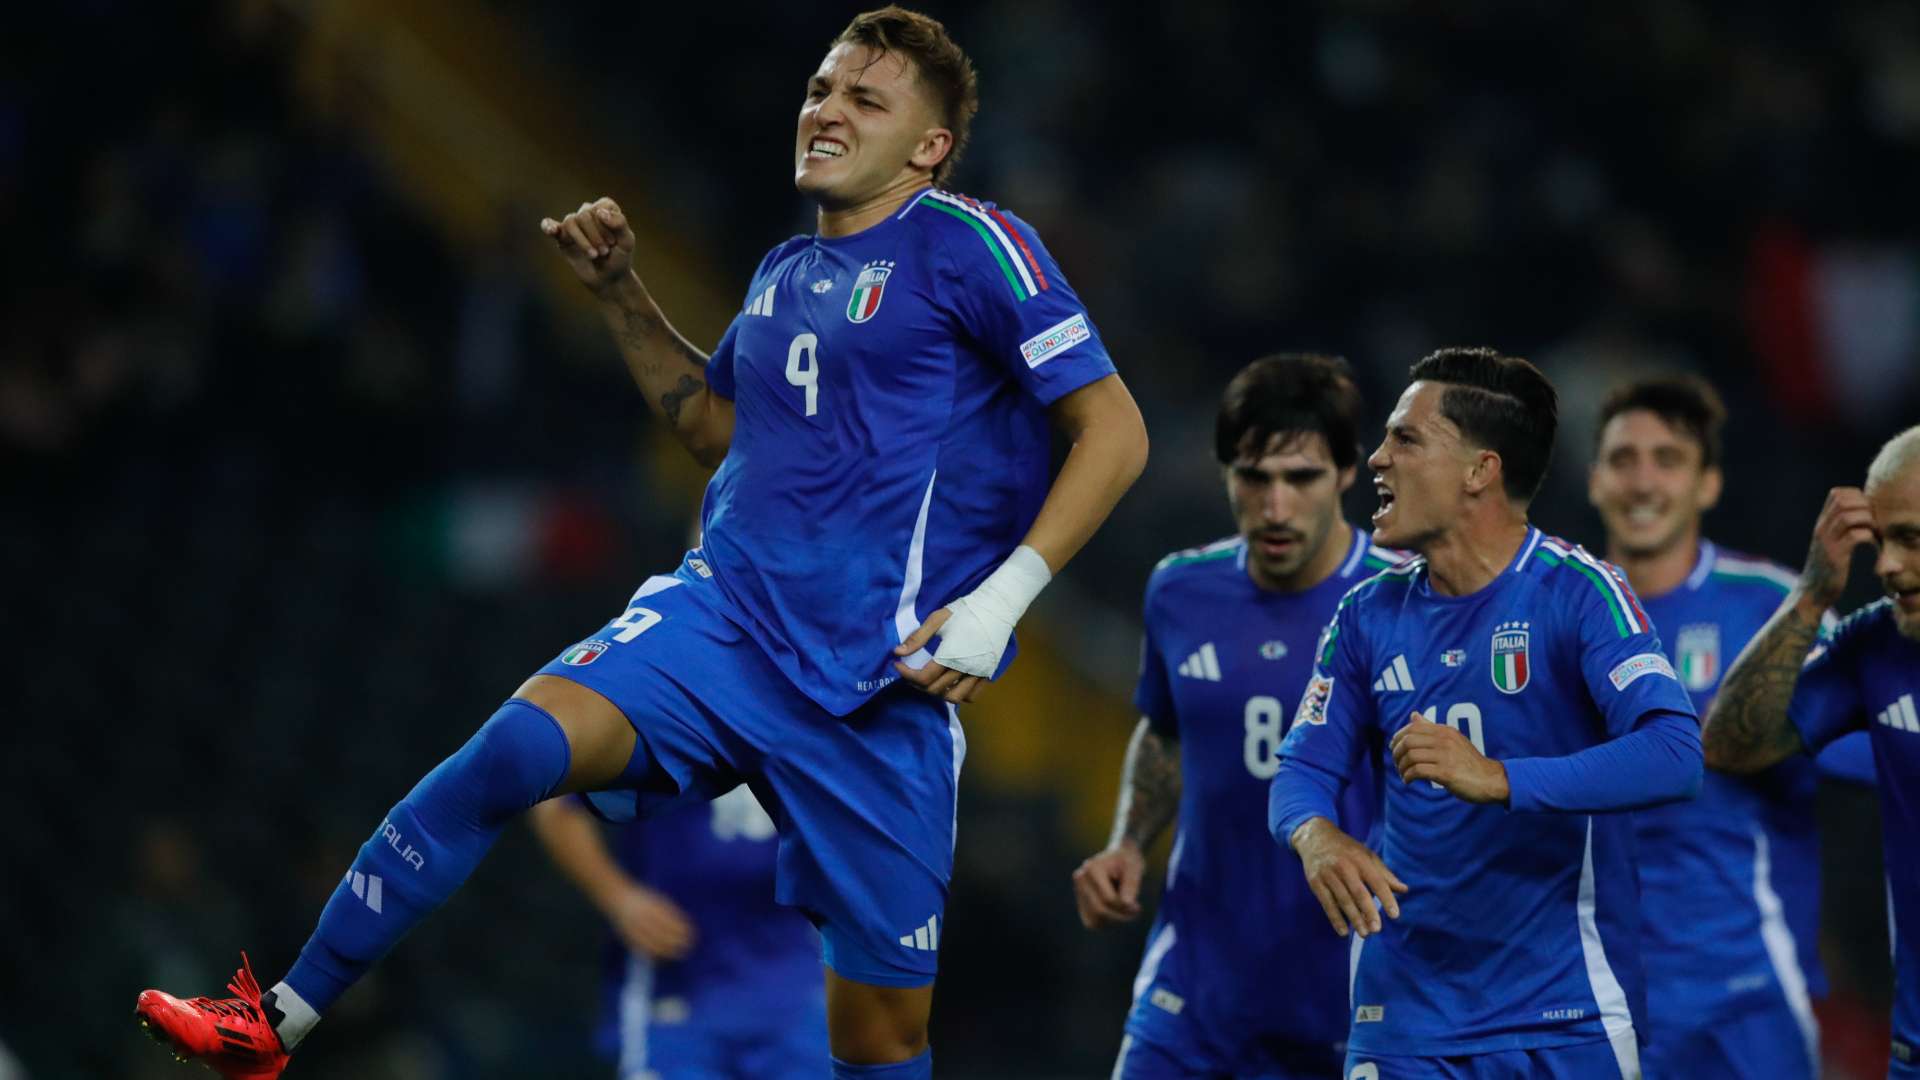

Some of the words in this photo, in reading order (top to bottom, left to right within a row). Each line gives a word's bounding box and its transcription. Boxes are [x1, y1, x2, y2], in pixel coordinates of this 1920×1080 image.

[1025, 322, 1086, 360] FOUNDATION
[785, 333, 819, 416] 9
[611, 607, 663, 644] 9
[1495, 636, 1525, 650] ITALIA
[1244, 696, 1283, 779] 8
[1424, 703, 1486, 789] 0
[379, 817, 425, 872] TALIA
